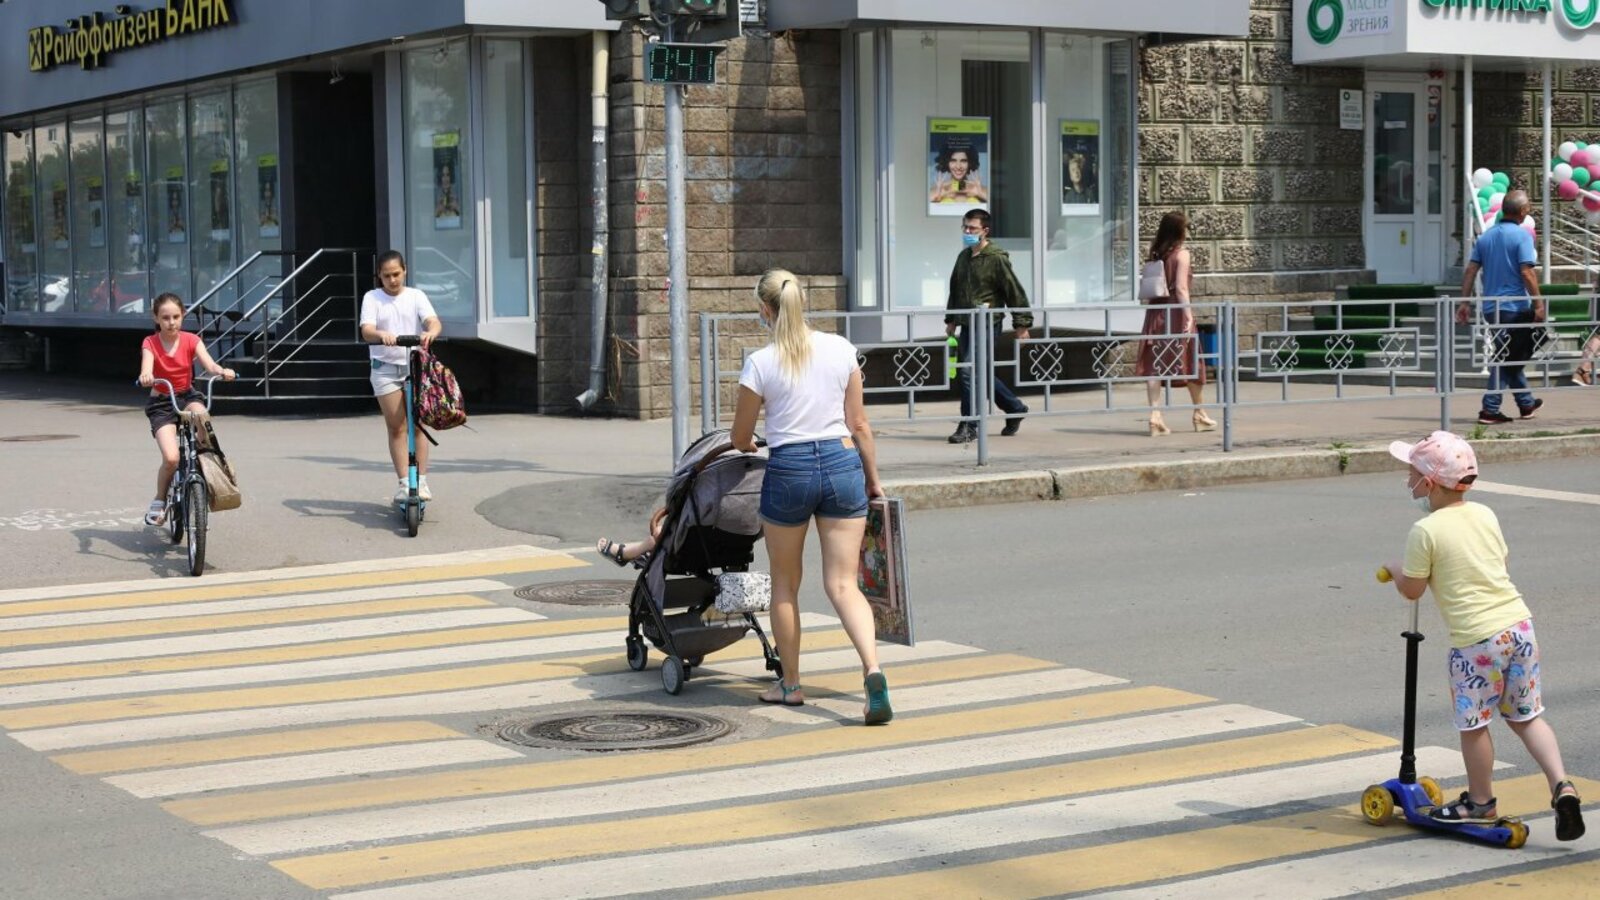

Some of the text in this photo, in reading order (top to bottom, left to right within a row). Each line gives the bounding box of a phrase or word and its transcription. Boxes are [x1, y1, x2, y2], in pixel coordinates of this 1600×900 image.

[43, 5, 160, 69] Райффайзен
[1347, 15, 1389, 33] ЗРЕНИЯ
[650, 45, 713, 81] 0:41
